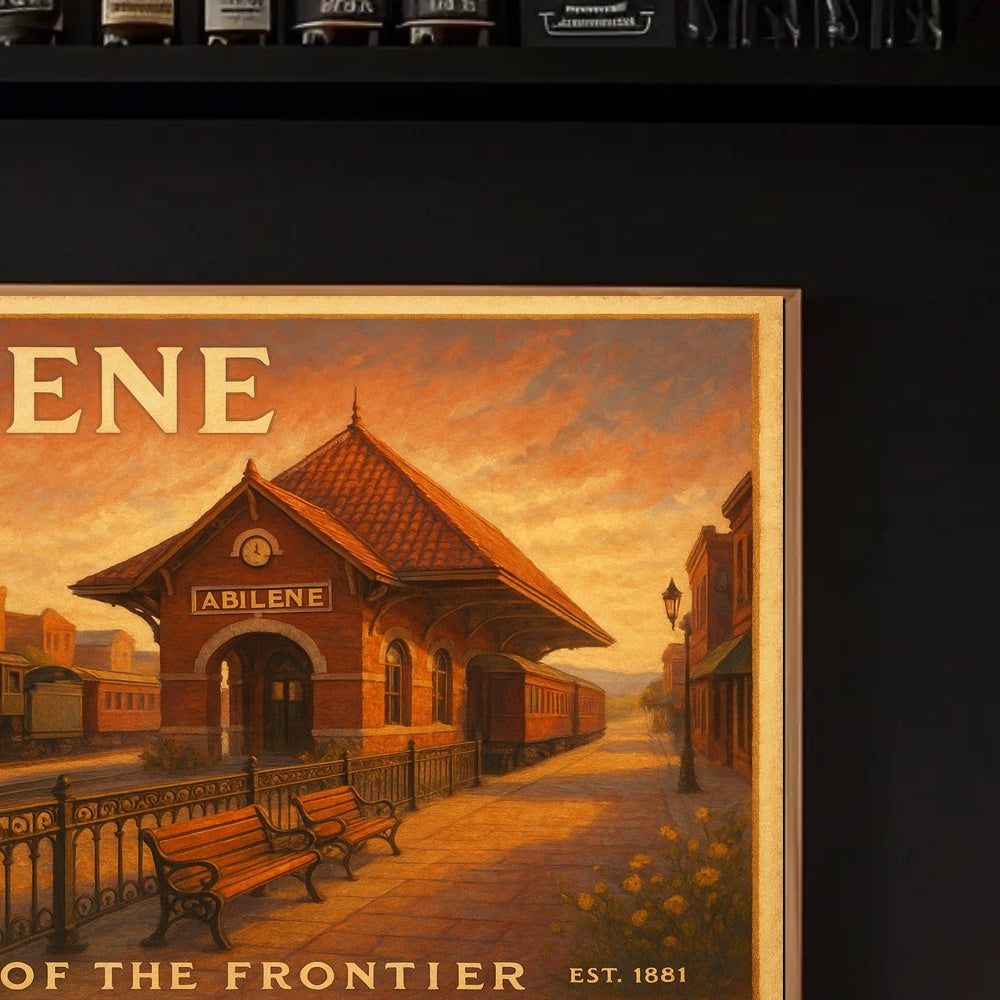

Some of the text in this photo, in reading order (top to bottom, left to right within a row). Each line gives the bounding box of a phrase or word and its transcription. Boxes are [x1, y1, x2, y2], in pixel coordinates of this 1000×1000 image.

[201, 588, 324, 610] ABILENE
[0, 961, 69, 990] OF
[95, 961, 197, 990] THE
[226, 961, 526, 990] FRONTIER
[569, 966, 687, 983] EST. 1881
